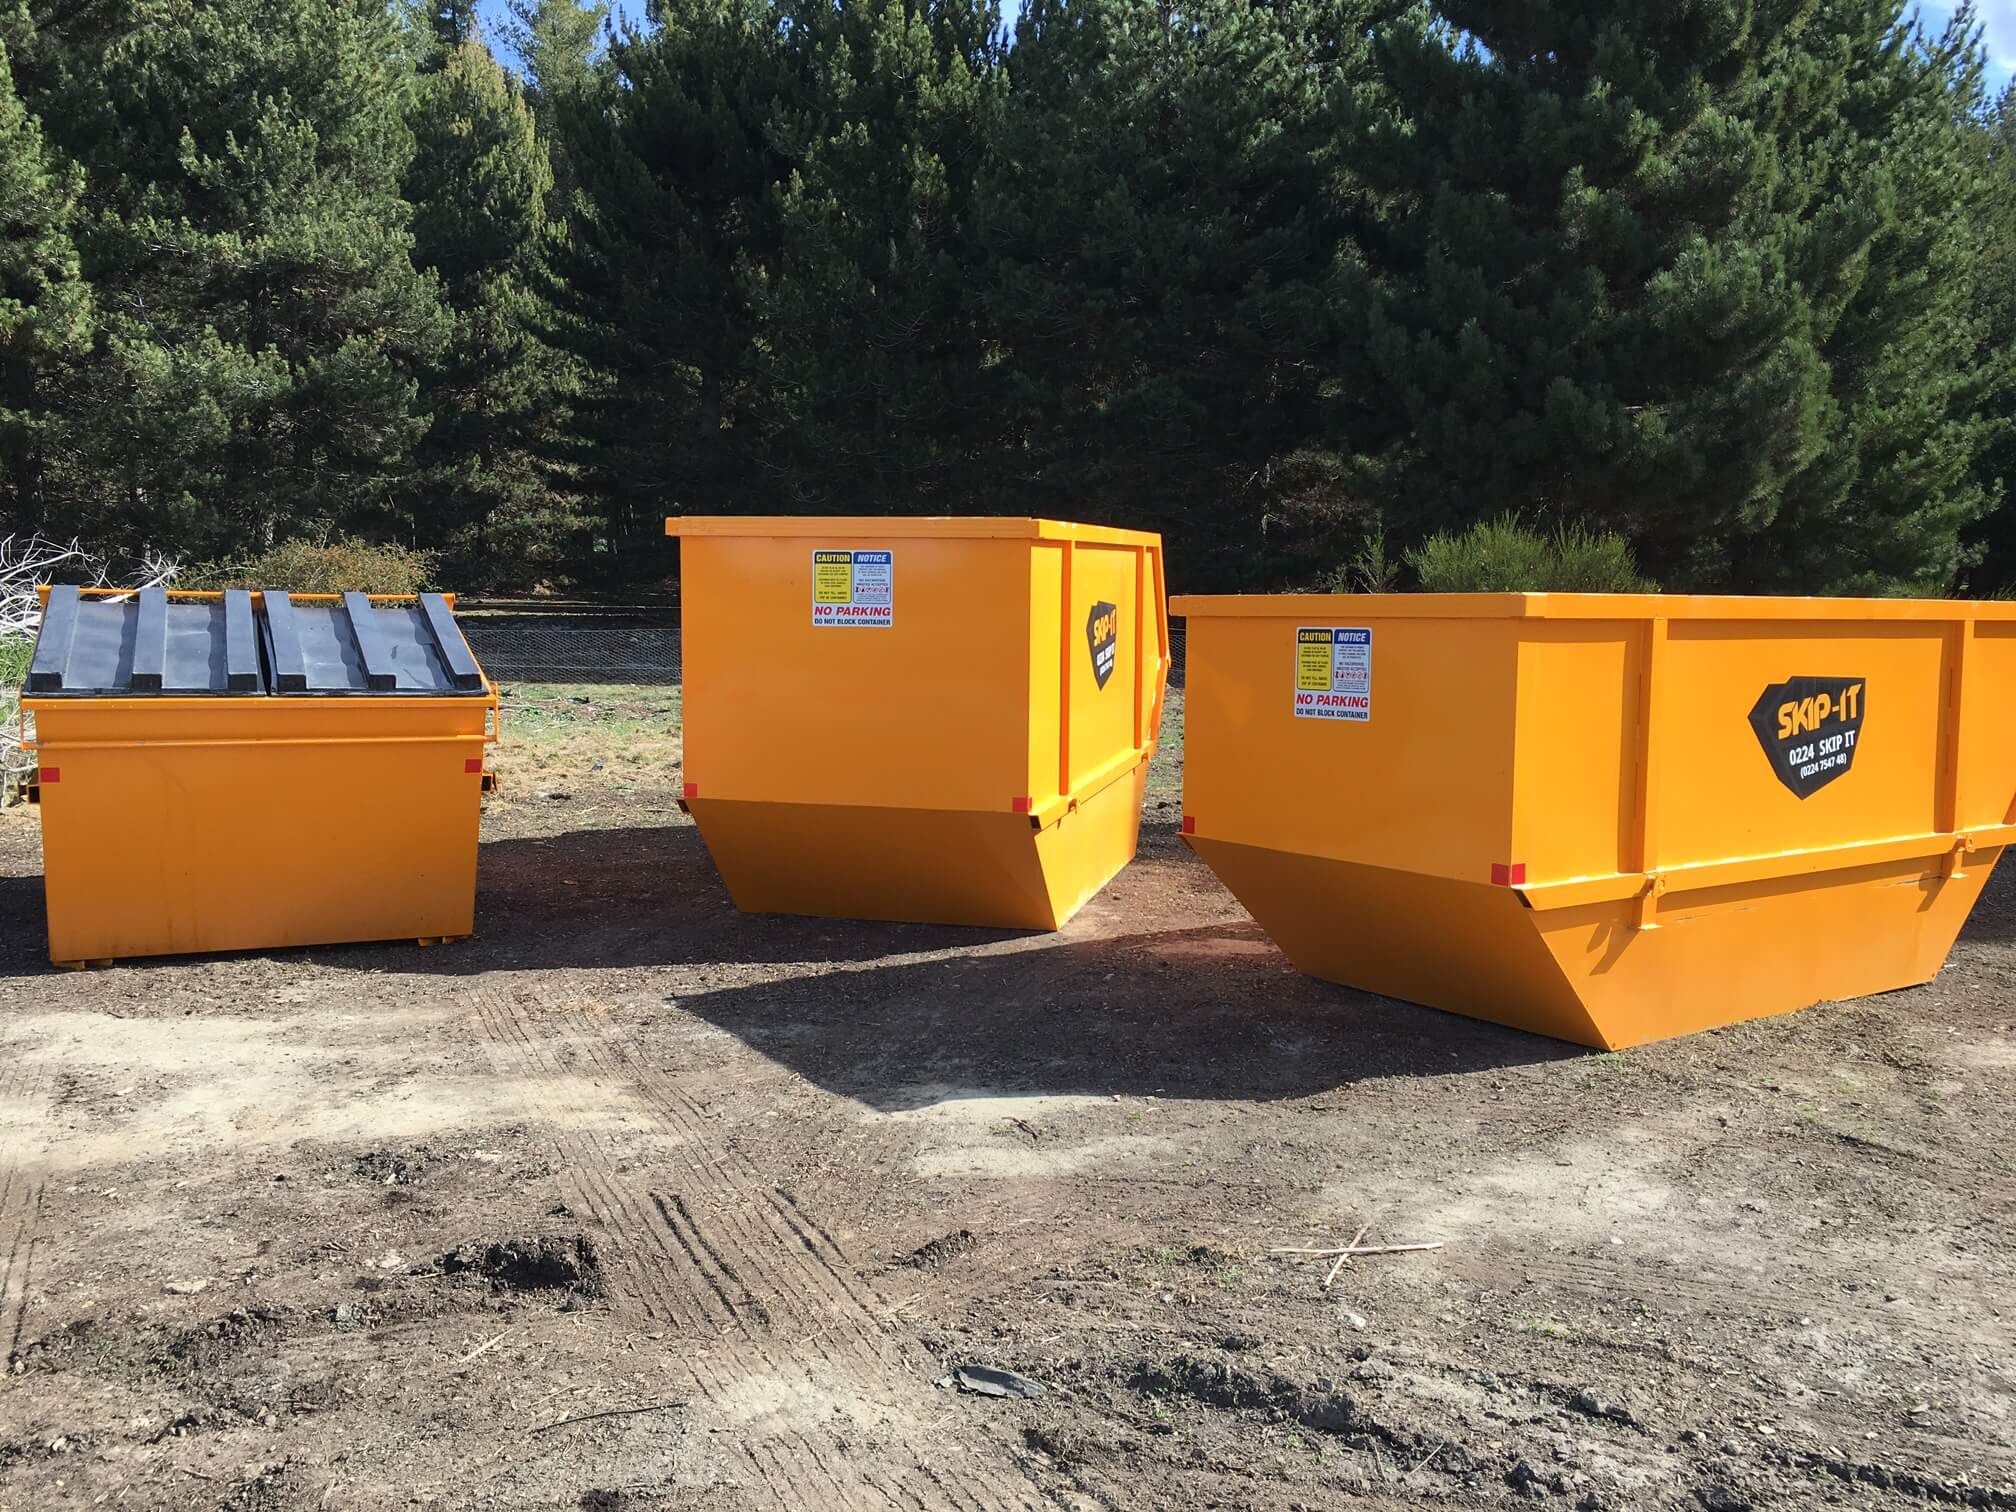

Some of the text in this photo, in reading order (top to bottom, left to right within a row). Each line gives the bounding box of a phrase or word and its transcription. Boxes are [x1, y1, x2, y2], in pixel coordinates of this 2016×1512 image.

[816, 554, 850, 562] CAUTION
[857, 554, 887, 562] NOTICE
[815, 606, 891, 616] NO PARKING
[857, 618, 891, 626] CONTAINER
[1300, 632, 1331, 641] CAUTION
[1338, 632, 1367, 641] NOTICE
[1297, 694, 1368, 708] NO PARKING
[1305, 708, 1316, 716] NOT
[1317, 709, 1336, 717] BLOCK
[1336, 710, 1368, 719] CONTAINER
[1778, 684, 1862, 740] SKIP-IT
[1789, 729, 1856, 766] 0224 SKIP IT
[1800, 752, 1847, 779] (0224 7547 48)
